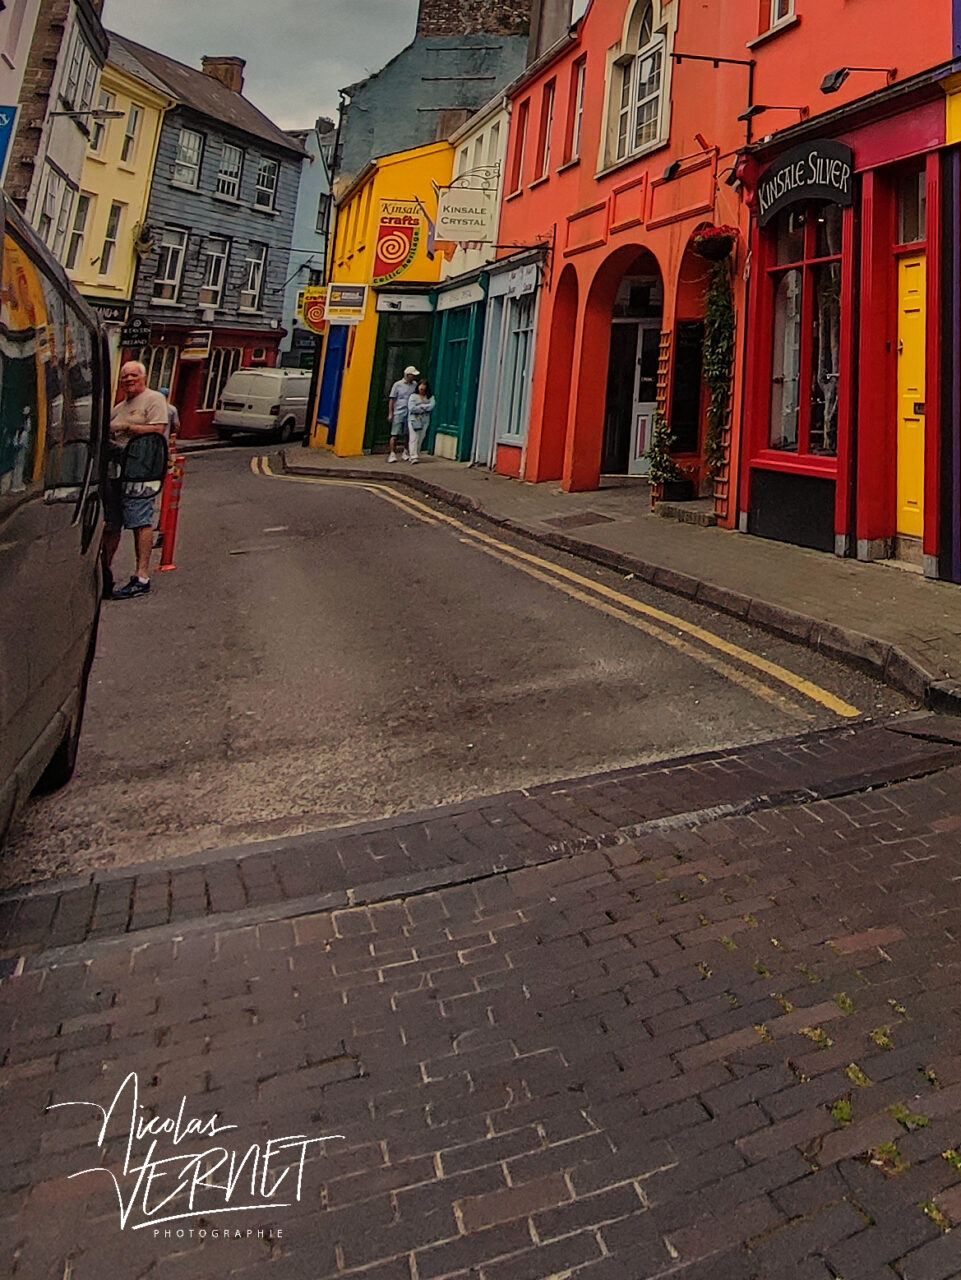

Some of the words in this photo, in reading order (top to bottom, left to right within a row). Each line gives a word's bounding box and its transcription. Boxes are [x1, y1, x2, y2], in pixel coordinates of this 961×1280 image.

[758, 160, 805, 215] KINSALE
[806, 151, 850, 193] SILVER
[381, 202, 421, 215] Kinsale
[442, 205, 487, 214] KINSALE
[380, 215, 420, 226] crafts
[440, 216, 486, 226] CRYSTAL
[373, 269, 401, 284] celtic
[401, 231, 420, 270] heritage
